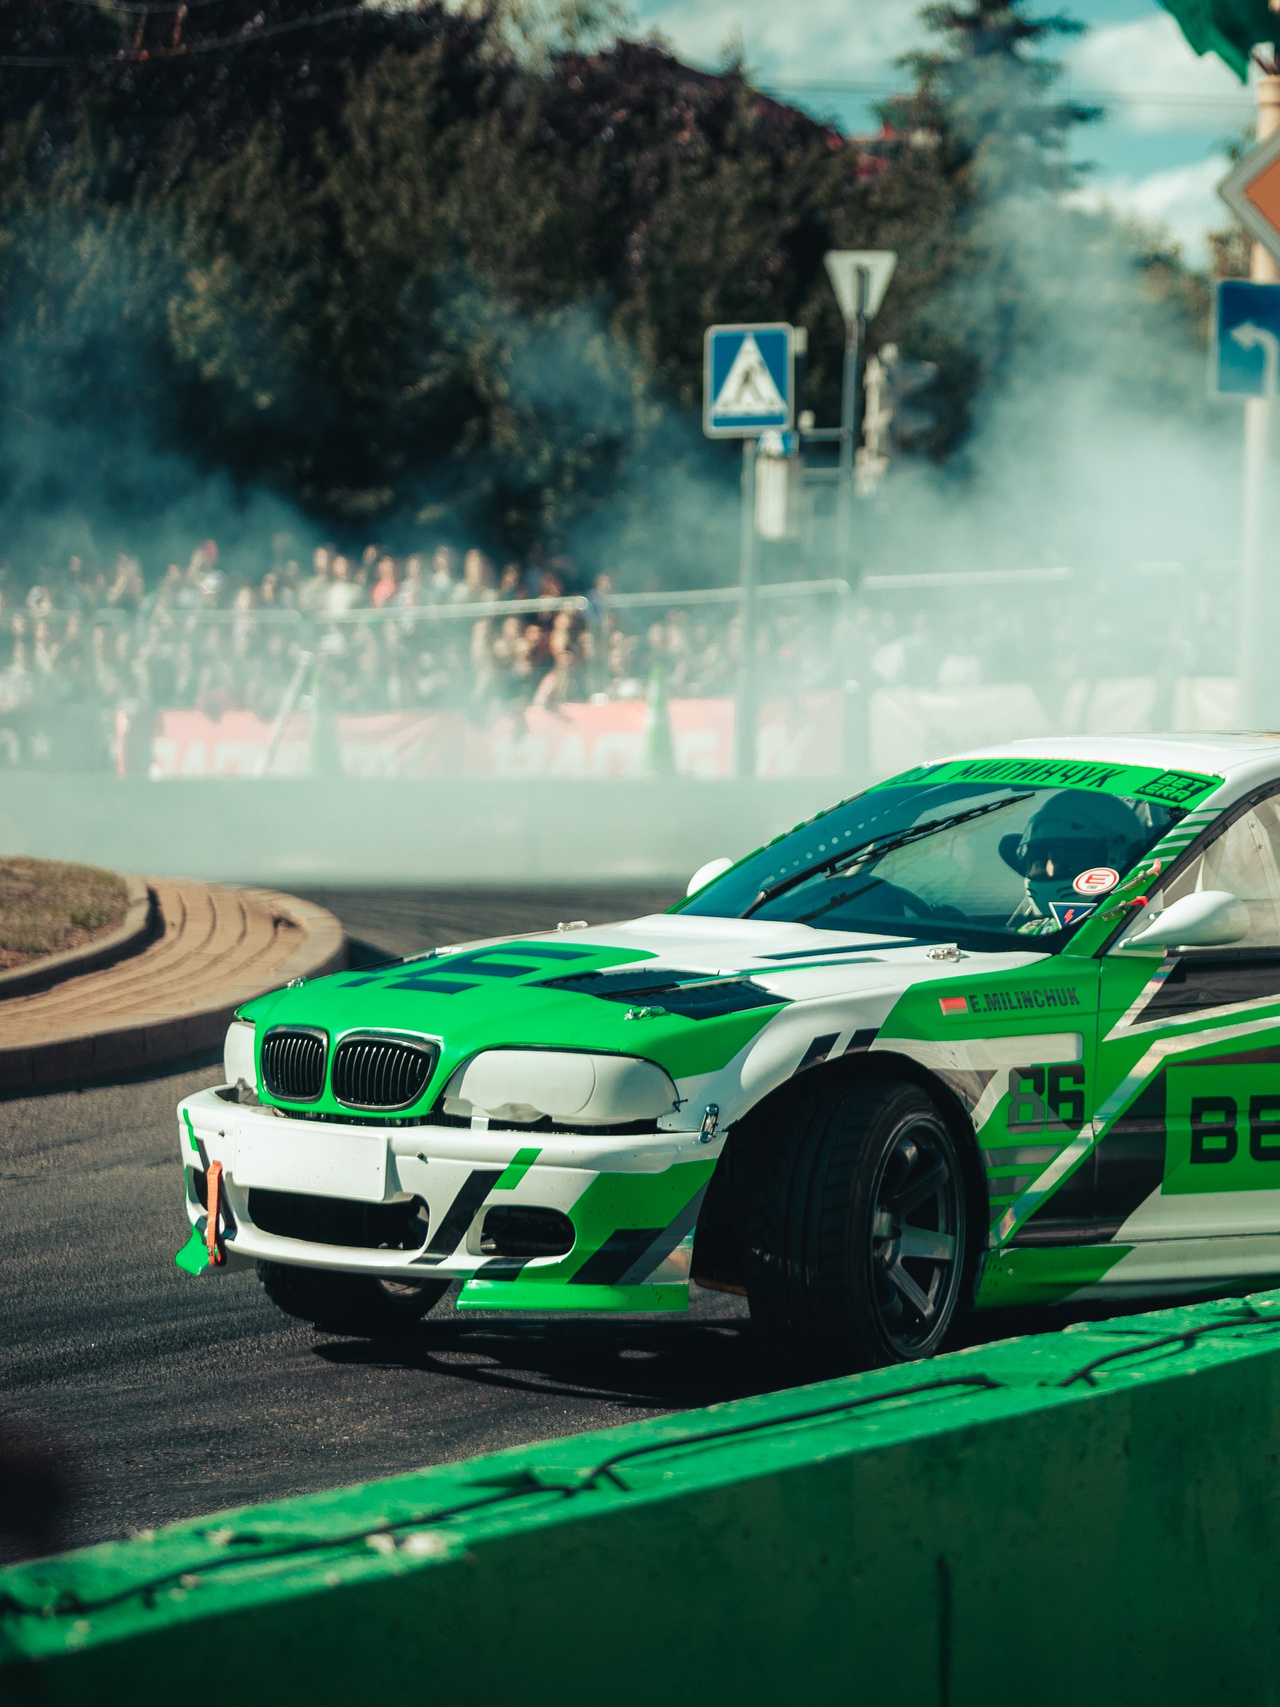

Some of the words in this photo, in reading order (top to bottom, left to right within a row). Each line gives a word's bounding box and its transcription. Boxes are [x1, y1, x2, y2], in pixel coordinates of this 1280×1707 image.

[948, 761, 1128, 788] МИЛИНЧУК
[1156, 773, 1208, 792] BET
[968, 987, 1081, 1013] E.MILINCHUK
[1007, 1064, 1086, 1135] 86
